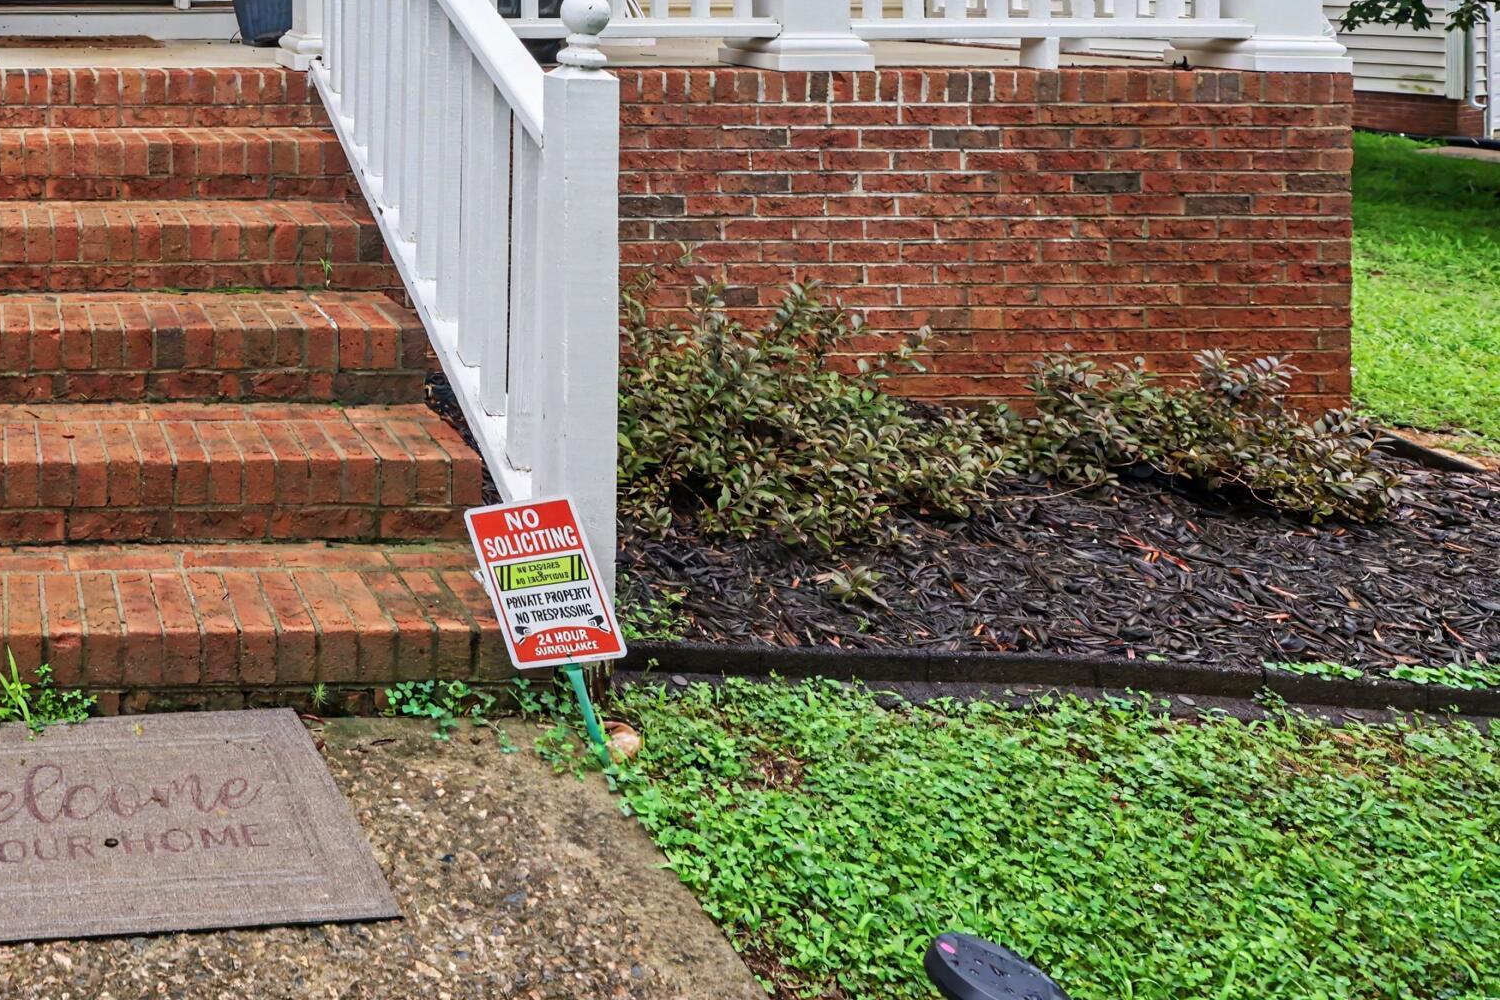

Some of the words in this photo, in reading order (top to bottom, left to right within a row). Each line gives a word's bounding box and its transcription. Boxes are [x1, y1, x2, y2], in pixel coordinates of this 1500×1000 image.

[504, 508, 540, 531] NO
[483, 525, 578, 559] SOLICITING
[506, 593, 544, 610] PRIVATE
[544, 586, 592, 604] PROPERTY
[515, 611, 530, 625] NO
[530, 603, 594, 622] TRESPASSING
[534, 640, 600, 656] SURVEILLANCE
[536, 633, 553, 646] 24
[553, 628, 589, 643] HOUR
[118, 823, 270, 855] HOME
